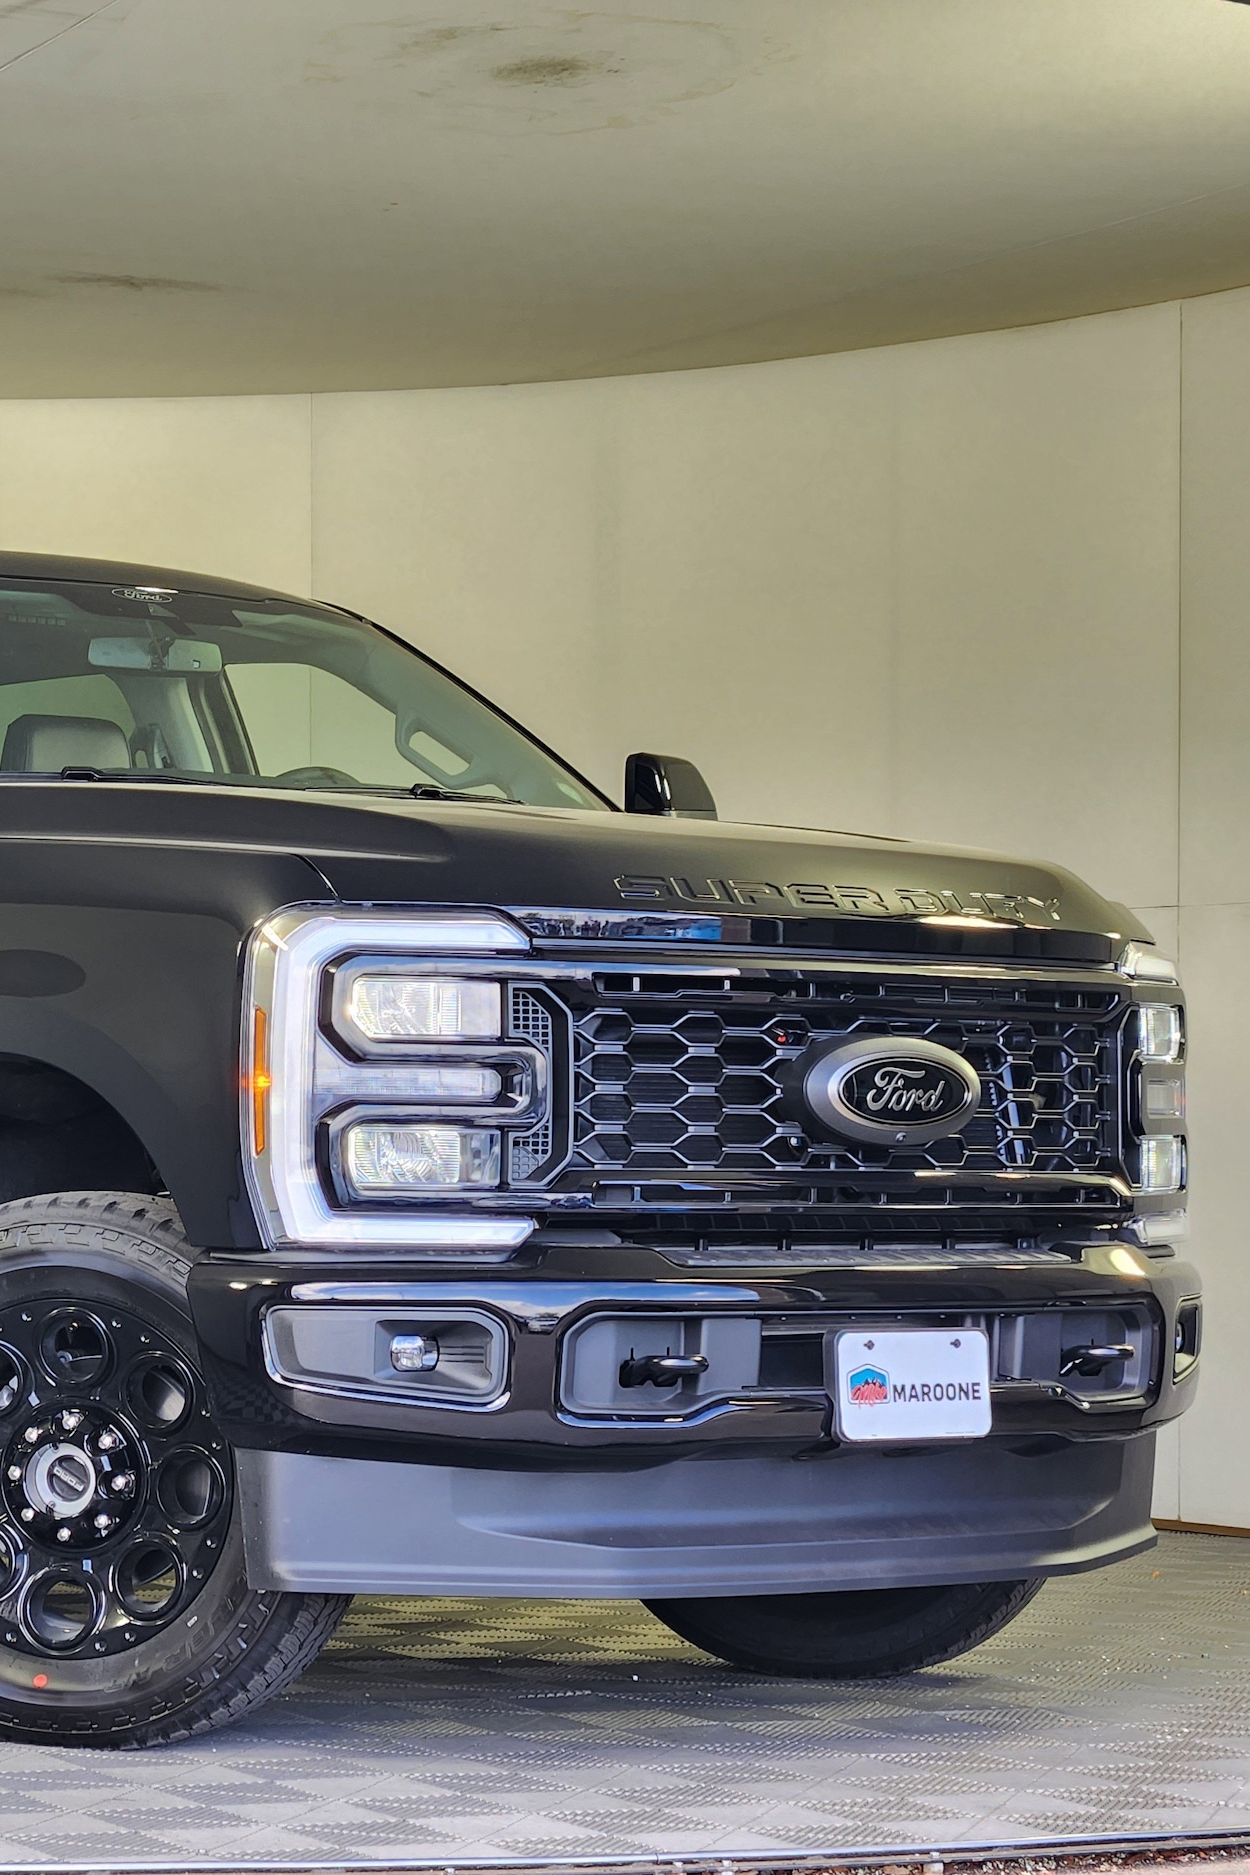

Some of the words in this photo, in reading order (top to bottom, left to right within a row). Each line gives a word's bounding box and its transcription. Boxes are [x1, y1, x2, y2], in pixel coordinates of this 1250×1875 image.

[613, 874, 890, 915] SUPER
[893, 887, 1061, 921] DUTY
[866, 1066, 946, 1112] Ford
[893, 1382, 982, 1403] MAROONE
[53, 1466, 85, 1492] FORD
